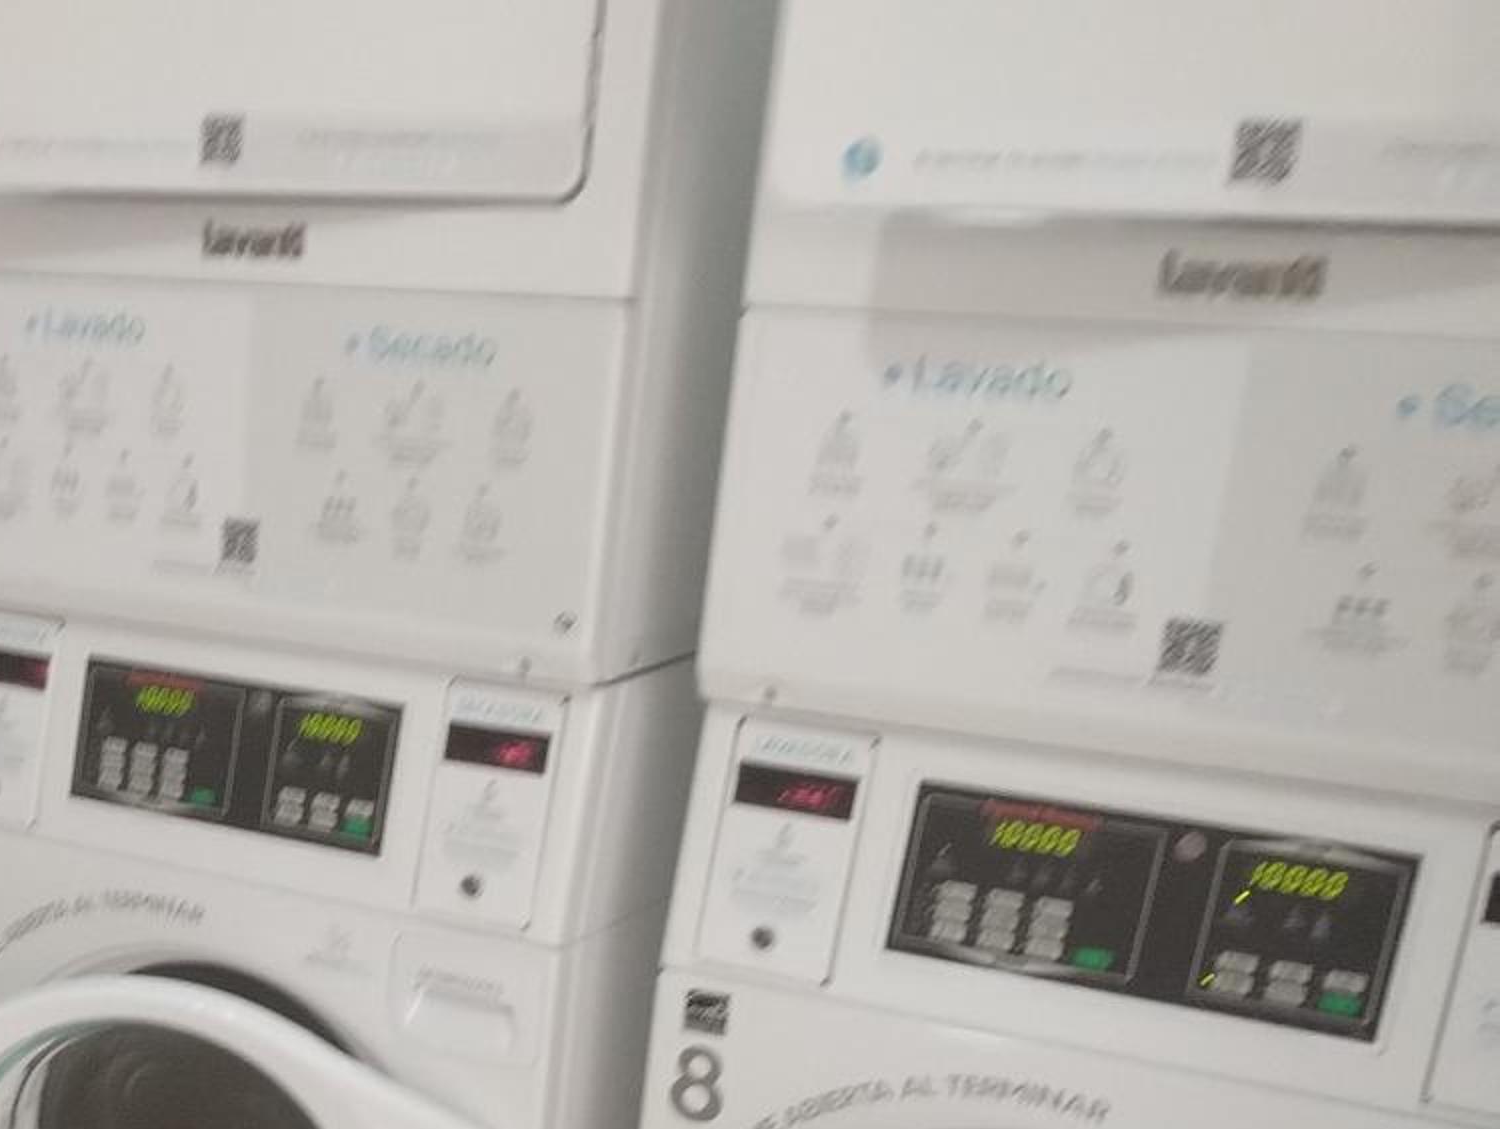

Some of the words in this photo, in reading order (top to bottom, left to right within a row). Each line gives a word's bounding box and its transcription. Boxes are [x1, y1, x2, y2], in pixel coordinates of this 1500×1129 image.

[909, 354, 1073, 399] Lavado
[670, 1045, 725, 1122] 8
[900, 1075, 936, 1099] AL
